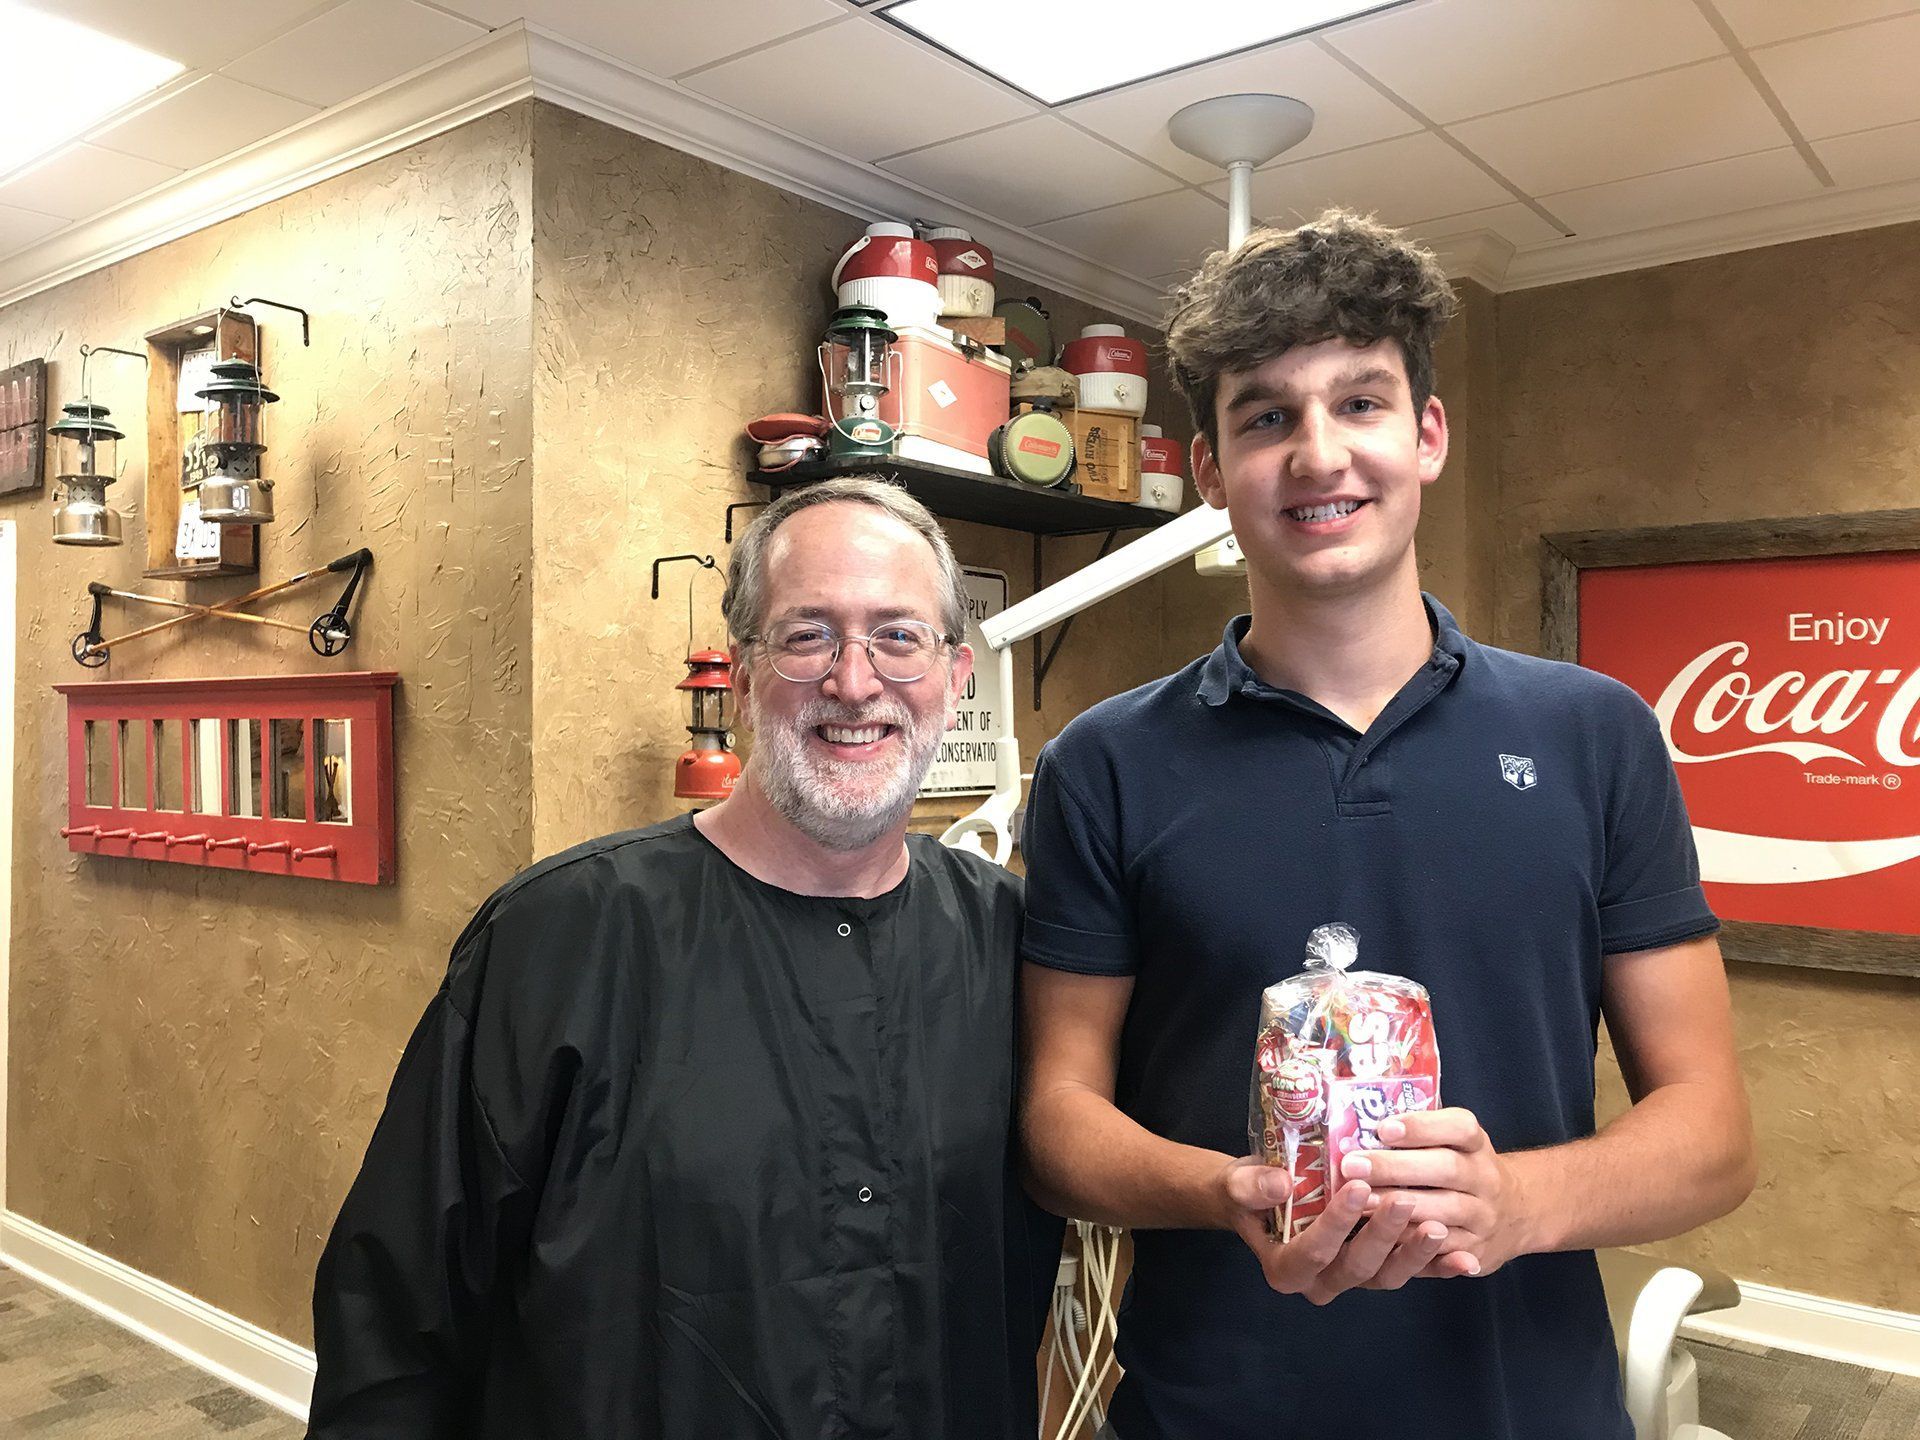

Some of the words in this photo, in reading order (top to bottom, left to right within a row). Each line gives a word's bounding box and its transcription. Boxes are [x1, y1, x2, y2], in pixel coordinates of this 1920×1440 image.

[1084, 426, 1101, 460] RIVERS
[1085, 462, 1100, 483] TWO
[1788, 612, 1891, 645] Enjoy
[980, 711, 992, 731] OF
[1803, 771, 1880, 786] Trade-mark
